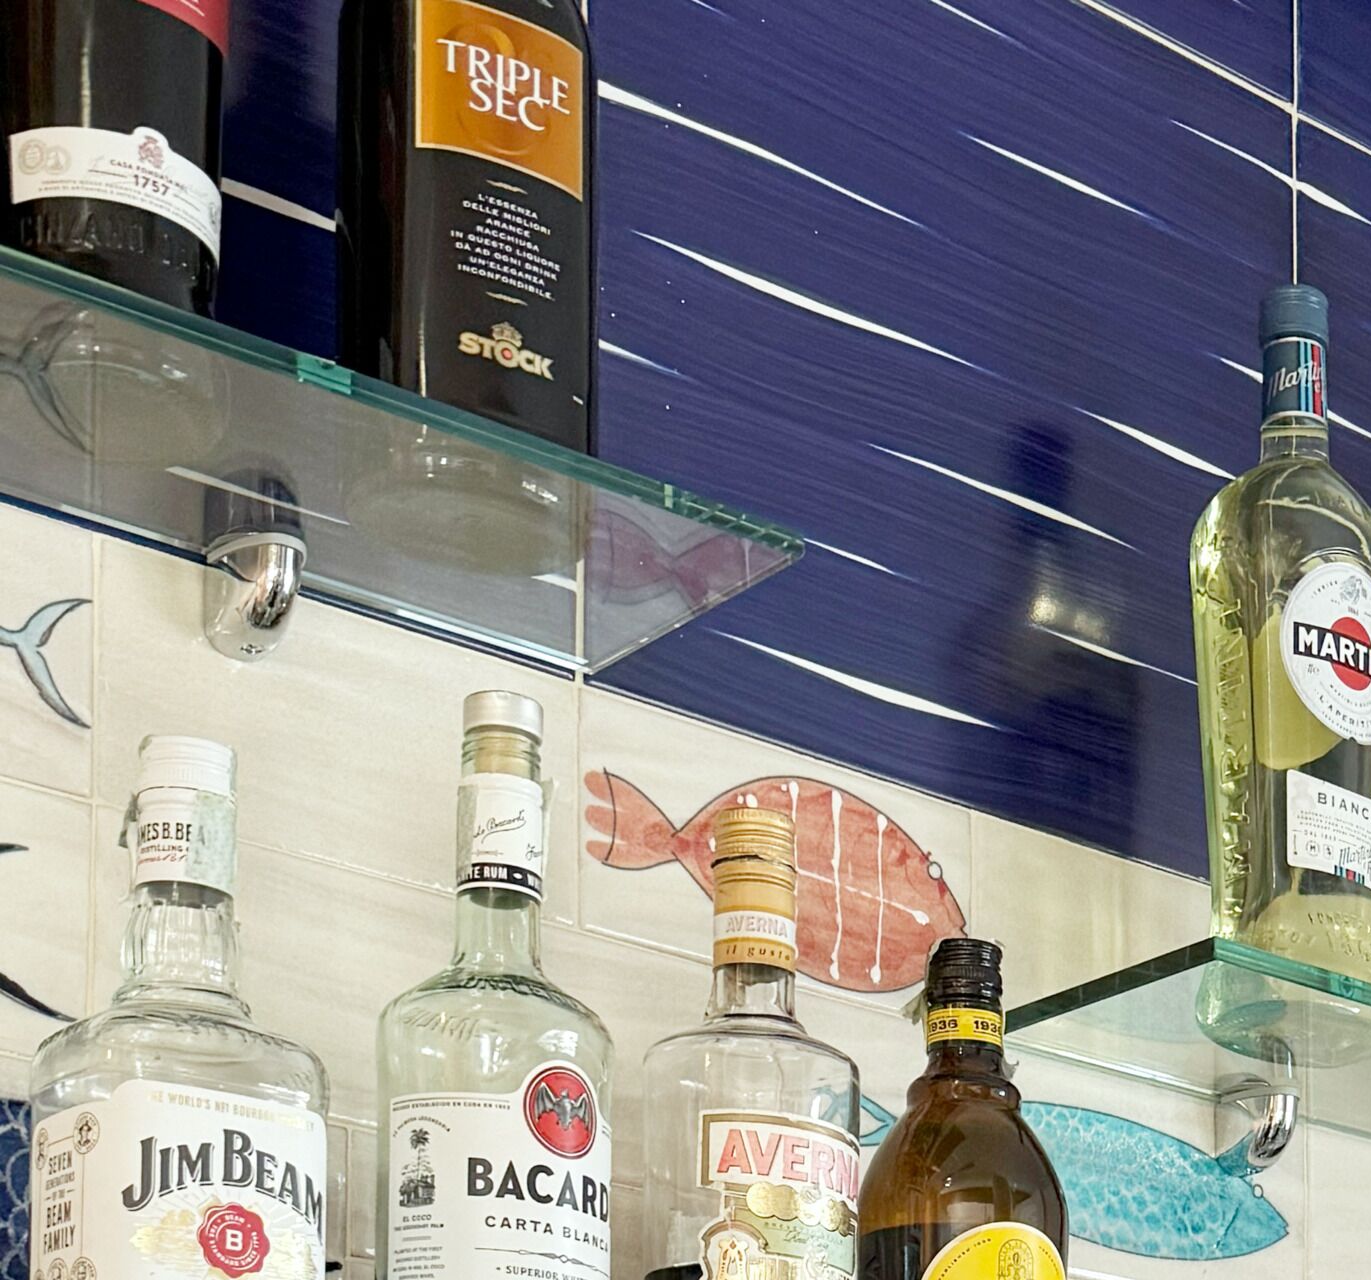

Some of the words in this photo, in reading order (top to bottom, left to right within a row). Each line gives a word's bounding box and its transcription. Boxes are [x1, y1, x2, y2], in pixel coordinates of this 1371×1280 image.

[436, 38, 570, 115] TRIPLE
[468, 77, 545, 131] SEC
[133, 174, 170, 196] 1757
[462, 200, 500, 217] DELLE
[503, 211, 551, 236] MIGLIORI
[478, 193, 538, 219] L'ESSENZA
[476, 225, 540, 252] RACCHIUSA
[486, 218, 531, 238] ARANCE
[450, 230, 464, 239] IN
[468, 233, 512, 252] QUESTO
[516, 249, 561, 272] LIQUORE
[475, 247, 491, 257] AD
[494, 251, 521, 267] OGNI
[525, 262, 558, 281] DRINK
[458, 331, 554, 381] STOCK
[483, 865, 508, 880] RUM
[725, 915, 789, 938] AVERNA
[928, 1019, 958, 1032] 936
[48, 1151, 73, 1175] SEVEN
[121, 1136, 215, 1212] JIM
[222, 1128, 324, 1247] BEAM
[467, 1156, 609, 1223] BACARD
[46, 1201, 72, 1229] BEAM
[484, 1214, 554, 1235] CARTA
[43, 1224, 76, 1255] FAMILY
[225, 1229, 243, 1251] B
[505, 1265, 559, 1280] SUPERIOR
